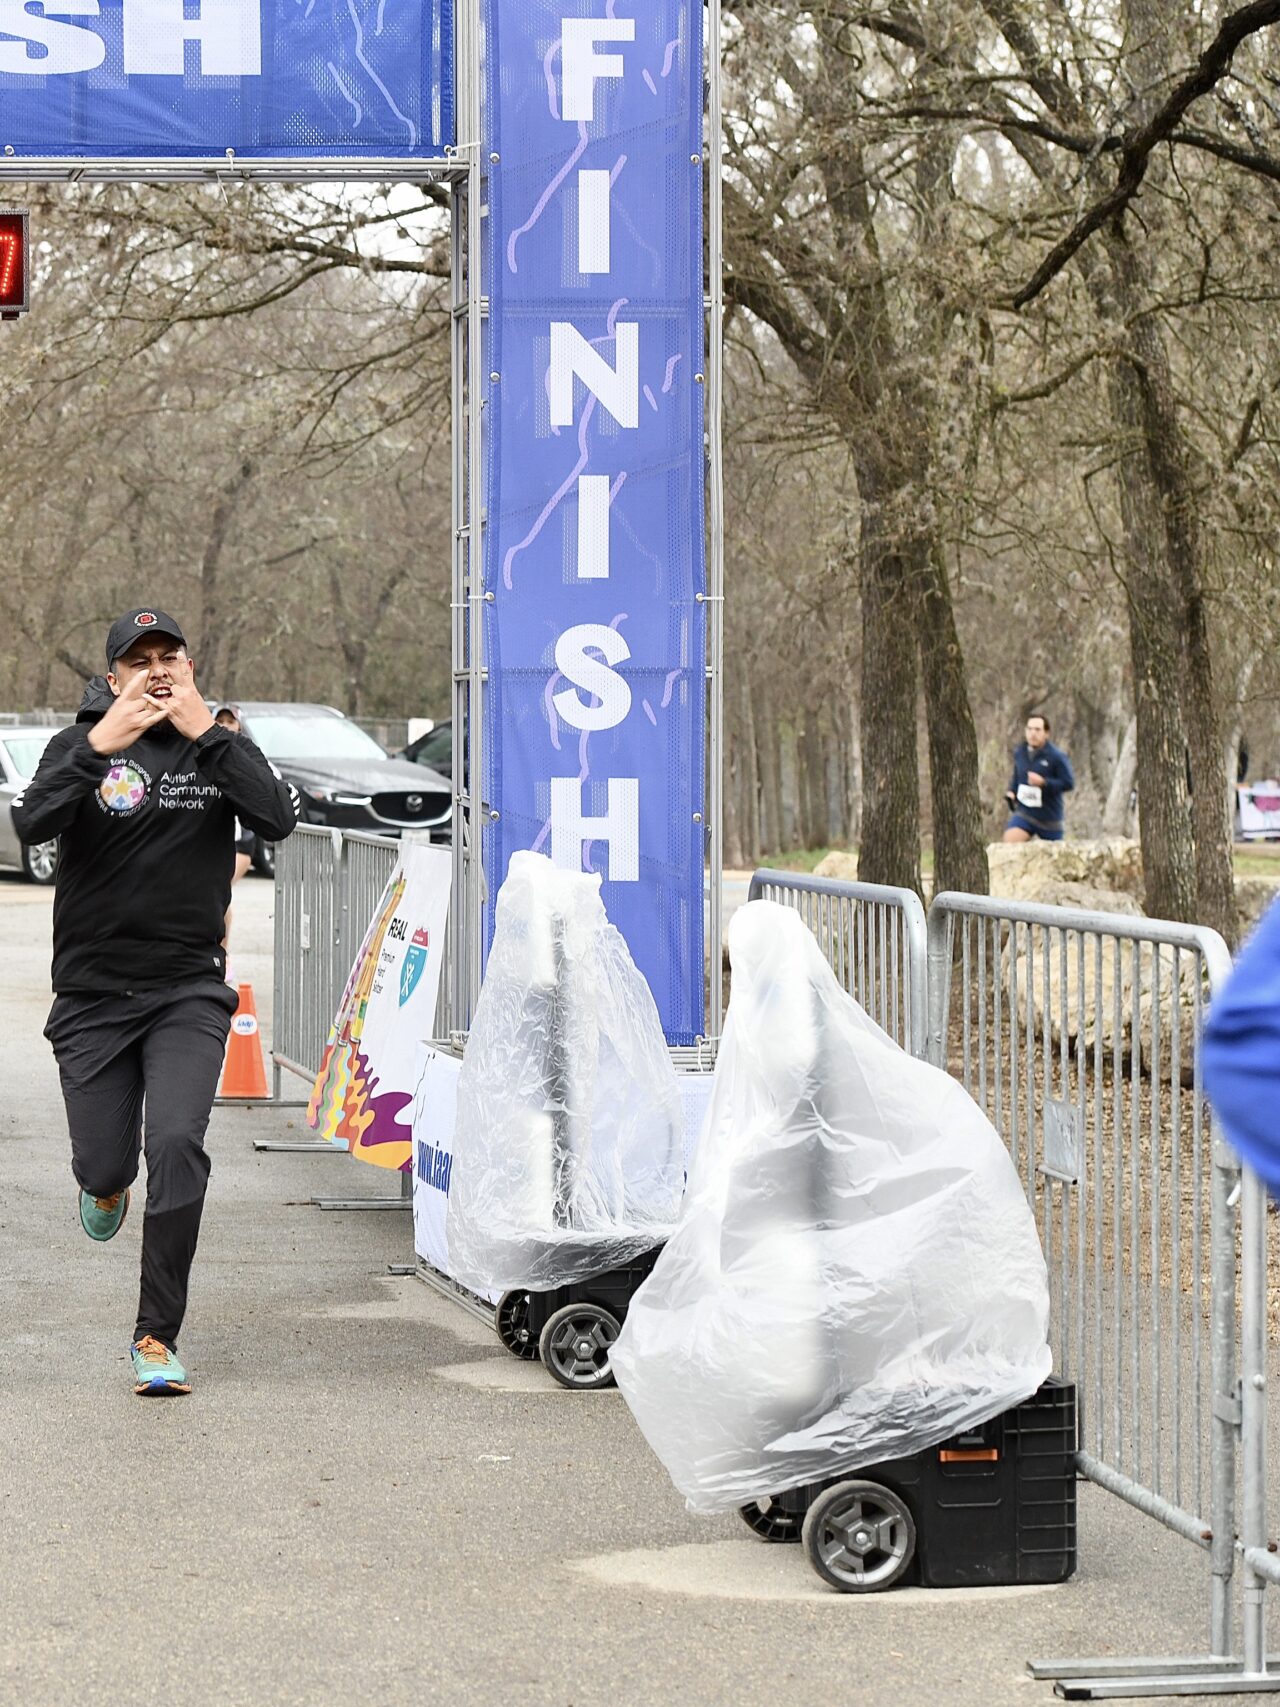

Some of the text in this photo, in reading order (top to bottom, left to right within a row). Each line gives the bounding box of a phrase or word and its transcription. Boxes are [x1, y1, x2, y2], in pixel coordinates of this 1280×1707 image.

[548, 18, 639, 882] FINISH
[110, 758, 127, 767] Early
[160, 772, 197, 785] Autism
[388, 917, 408, 941] REAL
